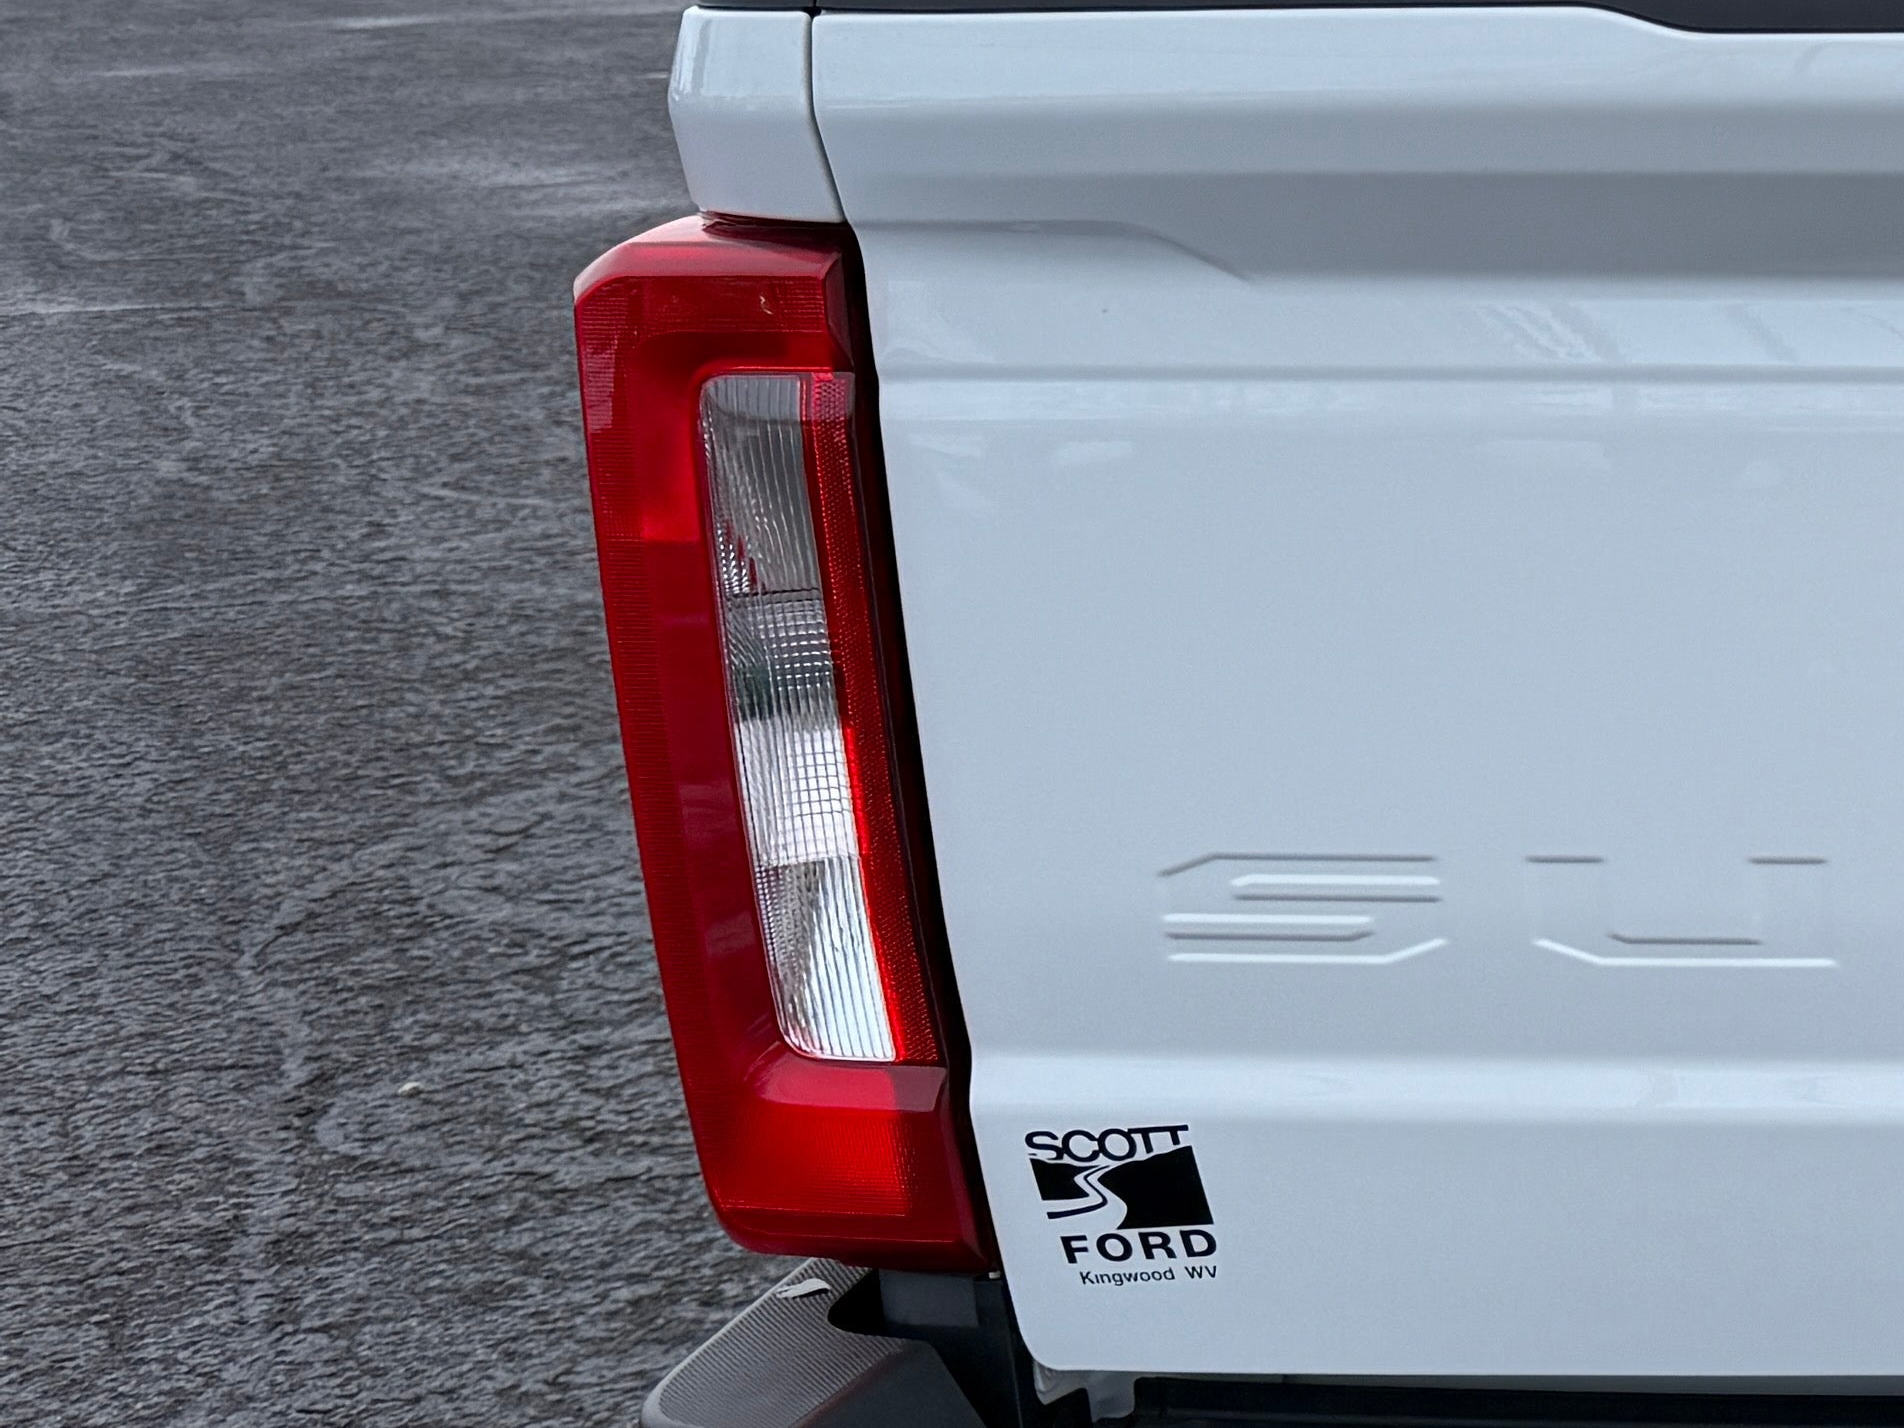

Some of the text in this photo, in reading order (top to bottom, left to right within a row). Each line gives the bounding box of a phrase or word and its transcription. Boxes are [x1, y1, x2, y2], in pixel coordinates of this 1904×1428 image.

[1024, 1124, 1189, 1163] SCOTT
[1059, 1229, 1218, 1265] FORD
[1079, 1265, 1218, 1287] Kingwood WV
